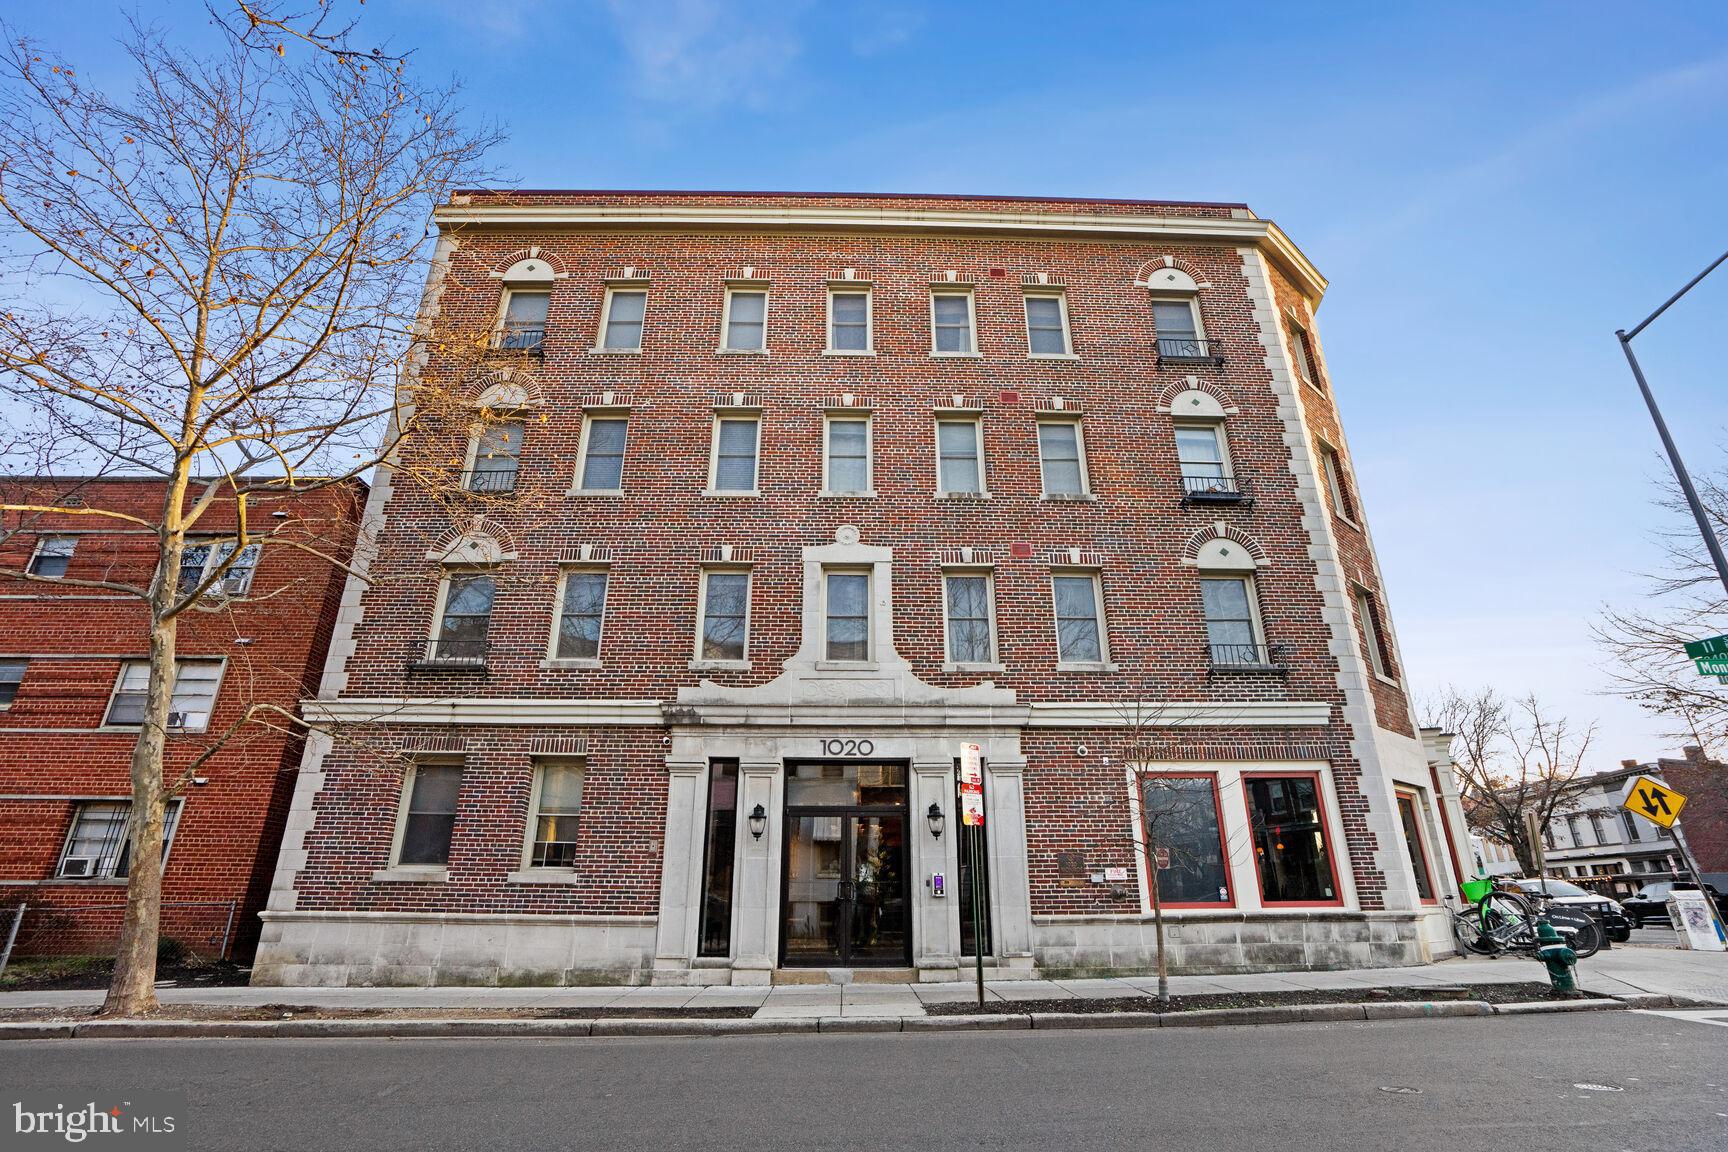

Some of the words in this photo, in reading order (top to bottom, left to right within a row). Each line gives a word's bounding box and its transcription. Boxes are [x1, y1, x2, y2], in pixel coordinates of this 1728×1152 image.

[1701, 640, 1715, 653] 11
[1700, 661, 1728, 674] Mon
[820, 739, 874, 756] 1020
